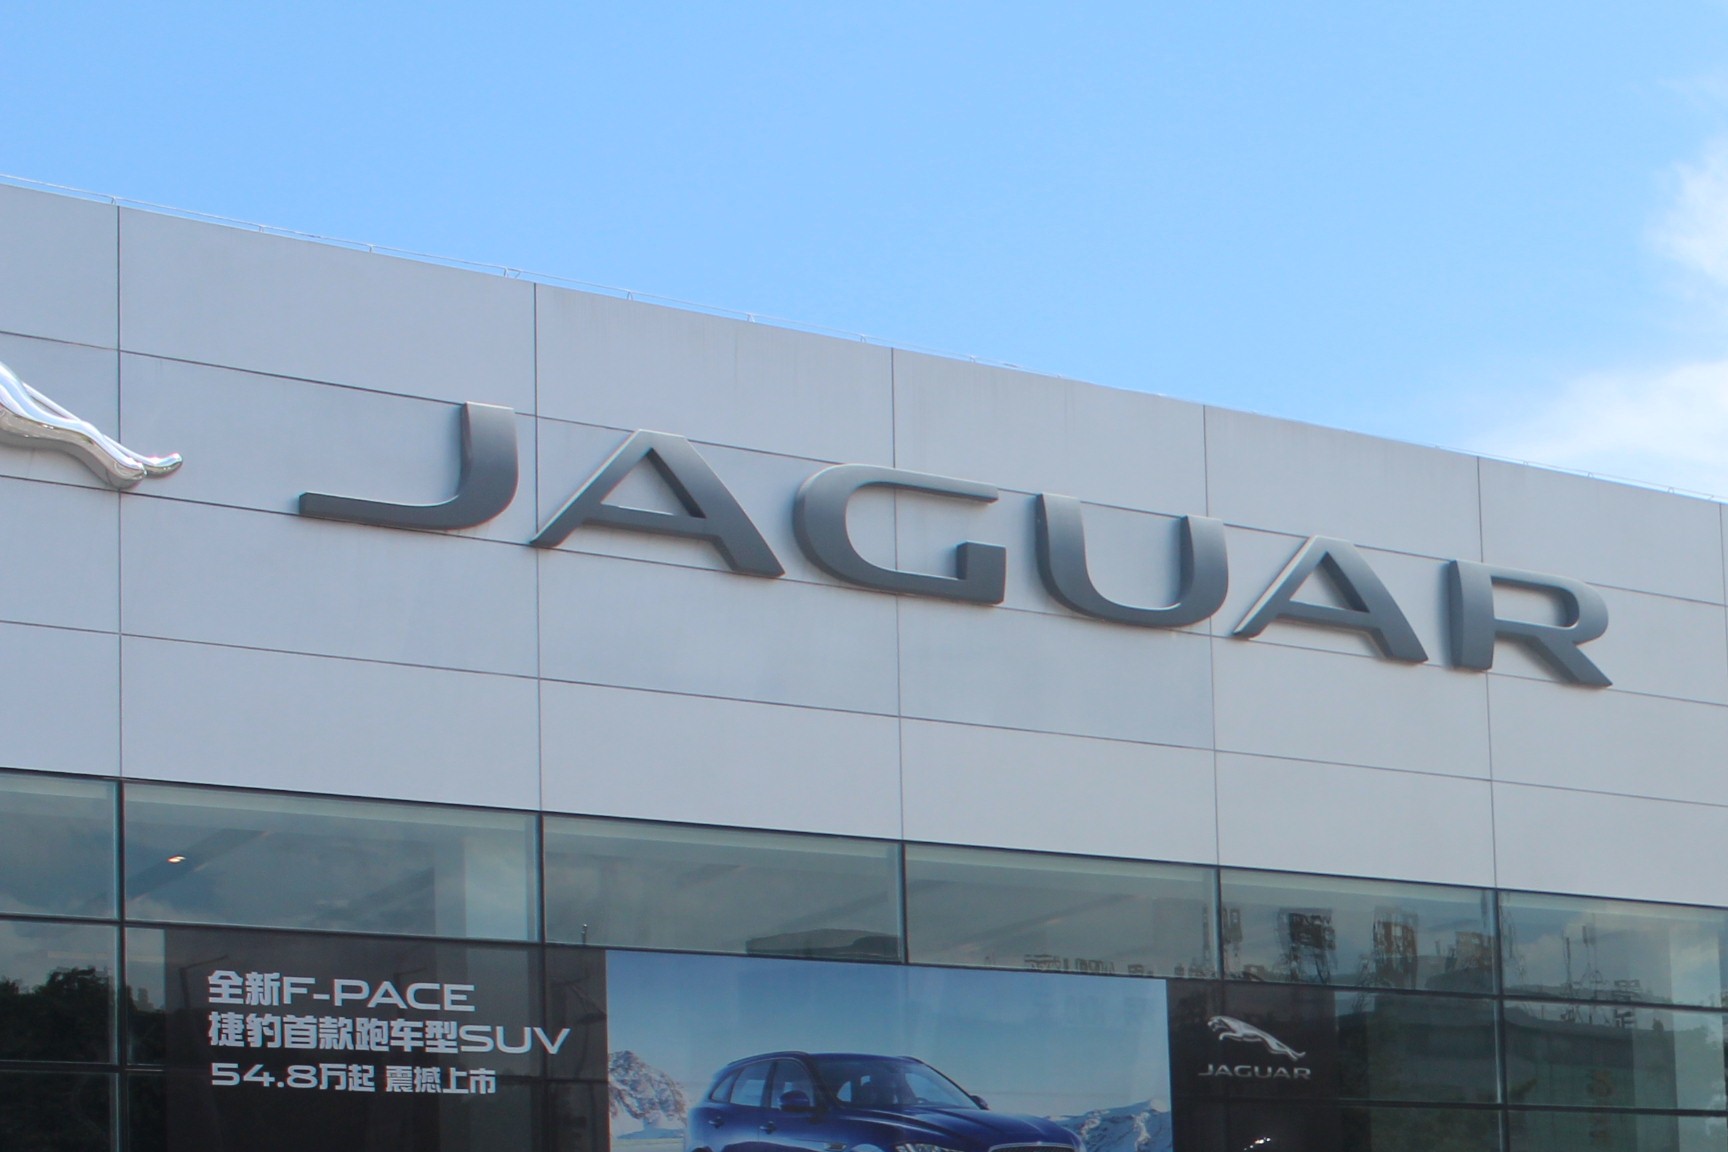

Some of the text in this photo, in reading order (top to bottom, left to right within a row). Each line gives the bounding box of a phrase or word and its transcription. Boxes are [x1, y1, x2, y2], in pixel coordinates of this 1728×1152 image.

[297, 400, 1613, 688] JAGUAR
[207, 970, 476, 1012] 全新F-PACE
[207, 1011, 571, 1055] 捷豹首款跑车型SUV
[210, 1061, 497, 1095] 54.8万起 震撼上市
[1198, 1063, 1312, 1080] JAGUAR
